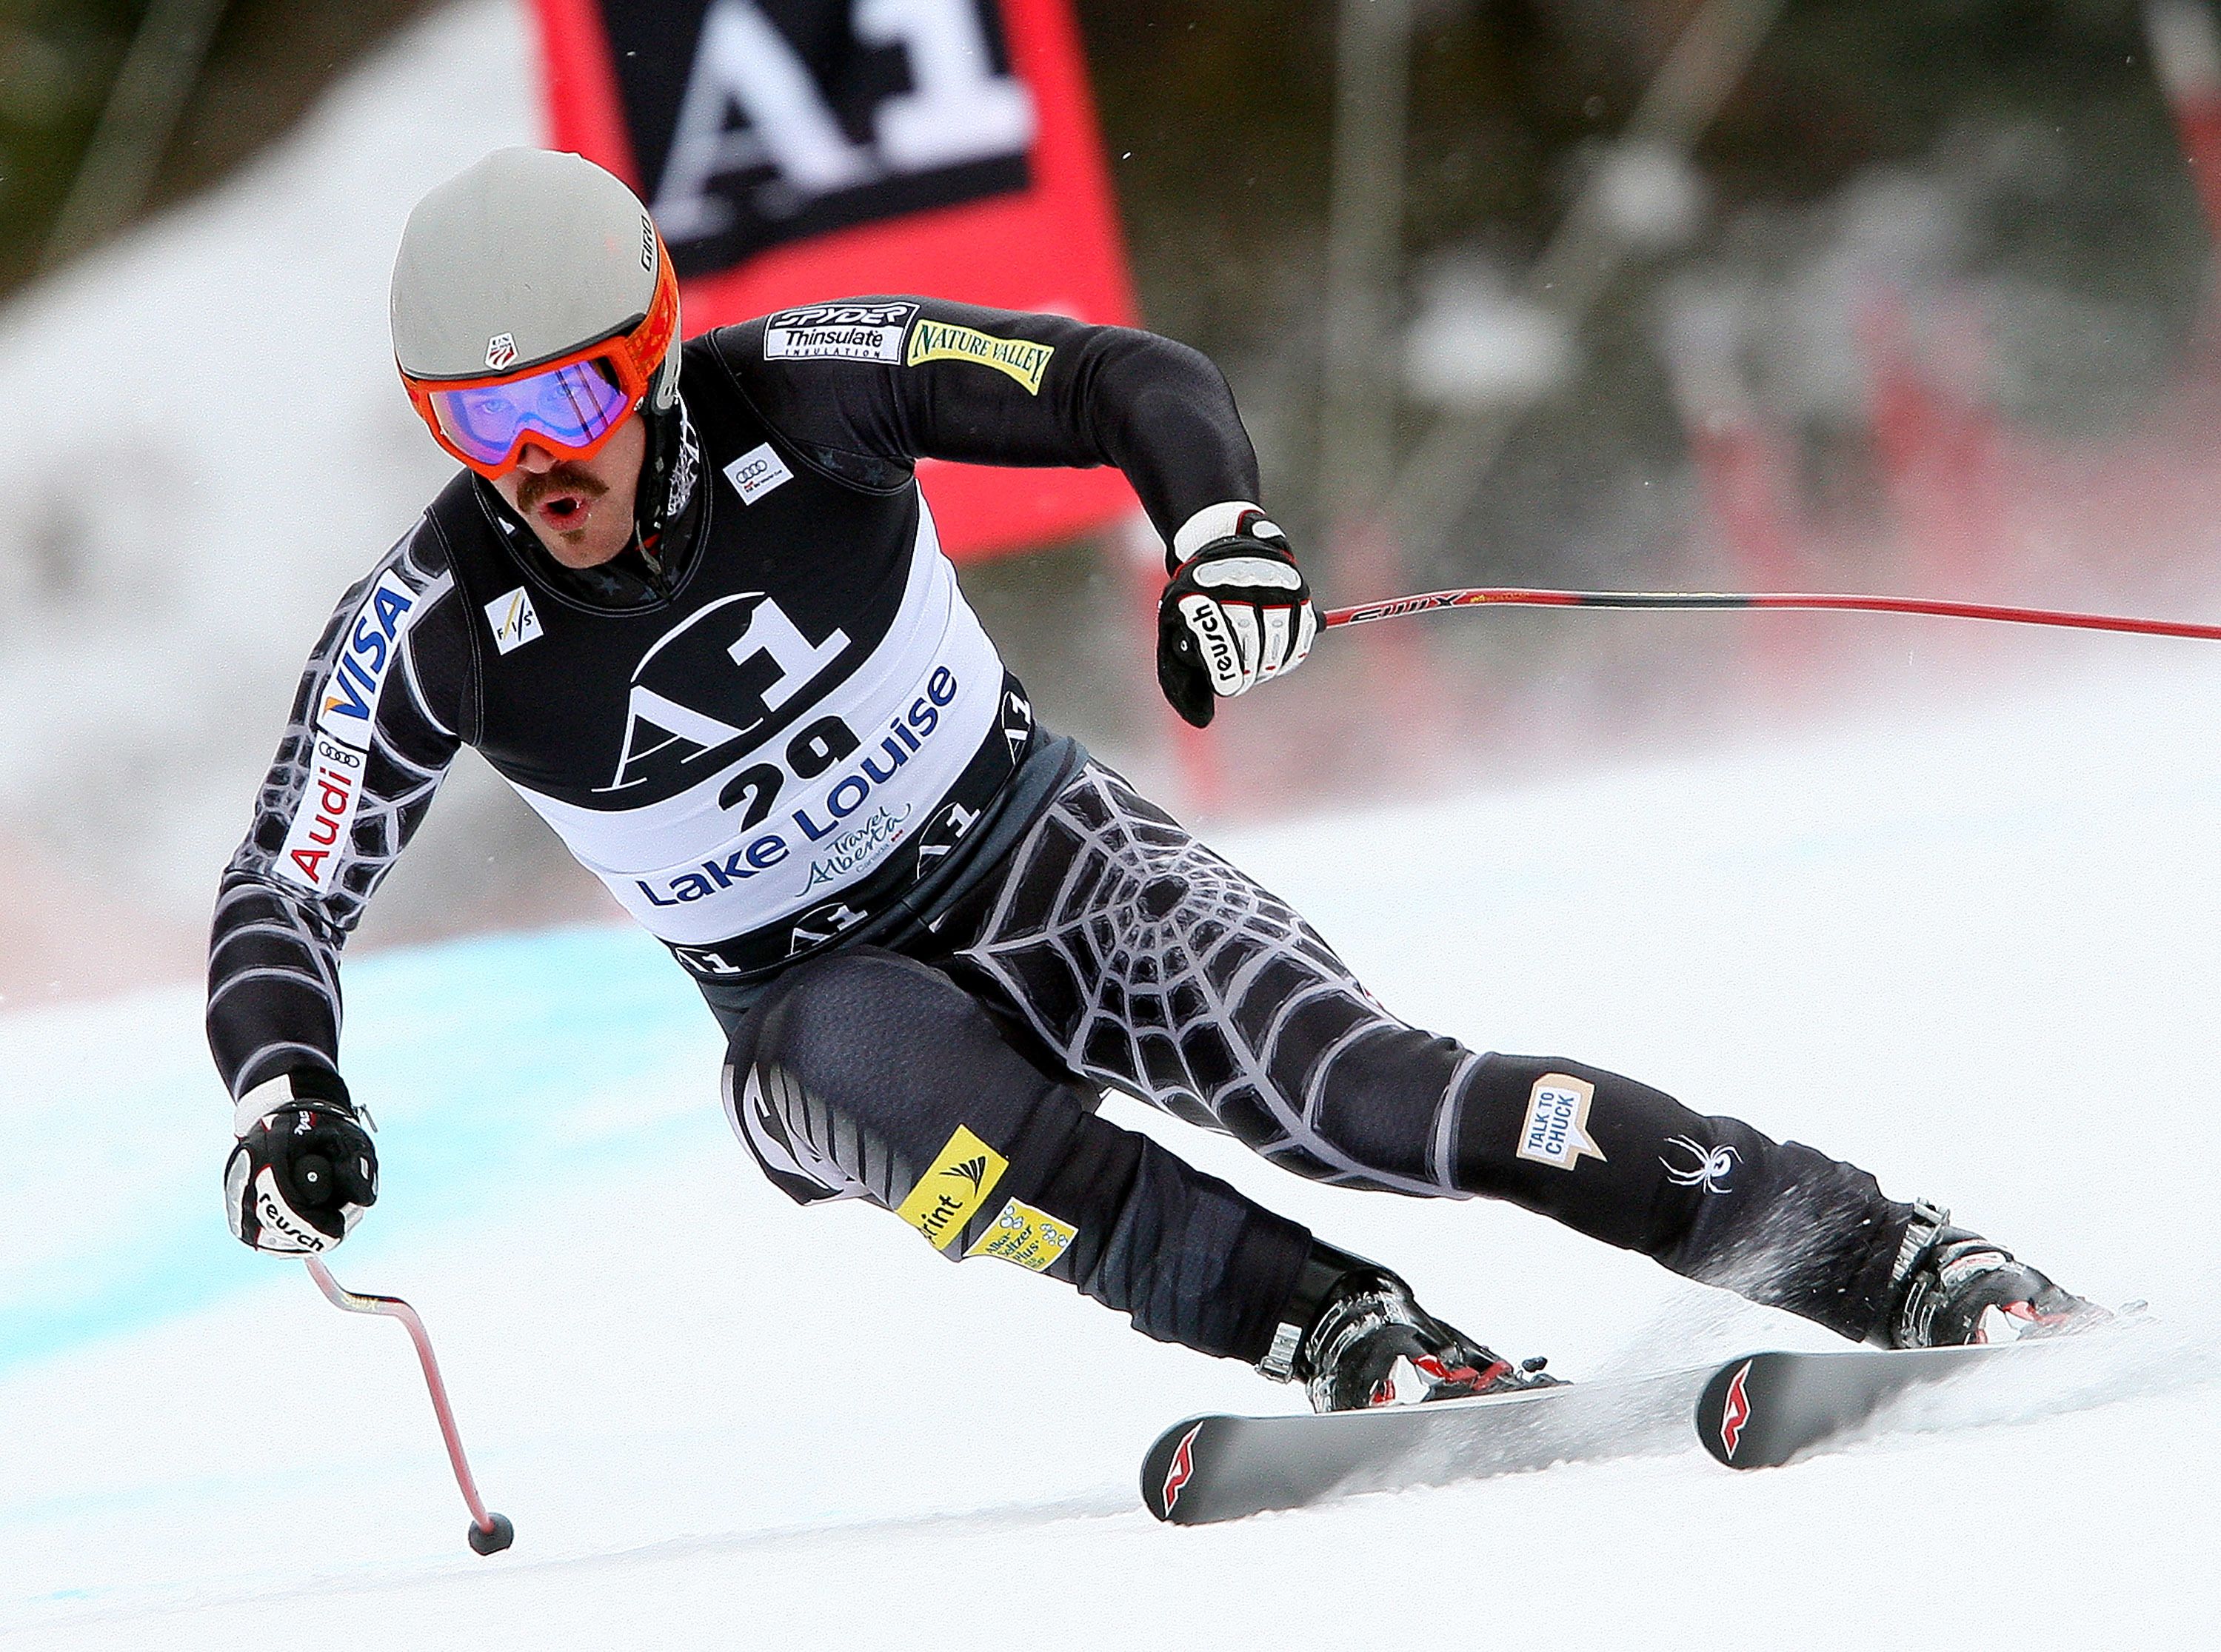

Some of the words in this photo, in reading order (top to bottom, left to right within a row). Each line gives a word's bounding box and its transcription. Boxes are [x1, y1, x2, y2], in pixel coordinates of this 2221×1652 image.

[652, 0, 1035, 248] A1
[641, 215, 652, 272] GIRO
[775, 307, 908, 327] SPYDER
[786, 328, 883, 347] Thinsulate
[912, 324, 988, 359] NATURE
[992, 342, 1050, 383] VALLEY
[323, 587, 413, 721] VISA
[1193, 603, 1236, 682] reusch
[592, 592, 852, 792] A1
[636, 835, 791, 908] Lake
[792, 665, 958, 843] Louise
[290, 768, 353, 885] Audi
[795, 803, 911, 897] Alberta
[824, 806, 890, 855] Travel
[784, 903, 869, 958] A1
[1528, 1114, 1547, 1150] TALK
[1538, 1091, 1554, 1108] TO
[1546, 1094, 1574, 1155] CHUCK
[258, 1192, 324, 1252] reusch
[921, 1194, 963, 1245] rint
